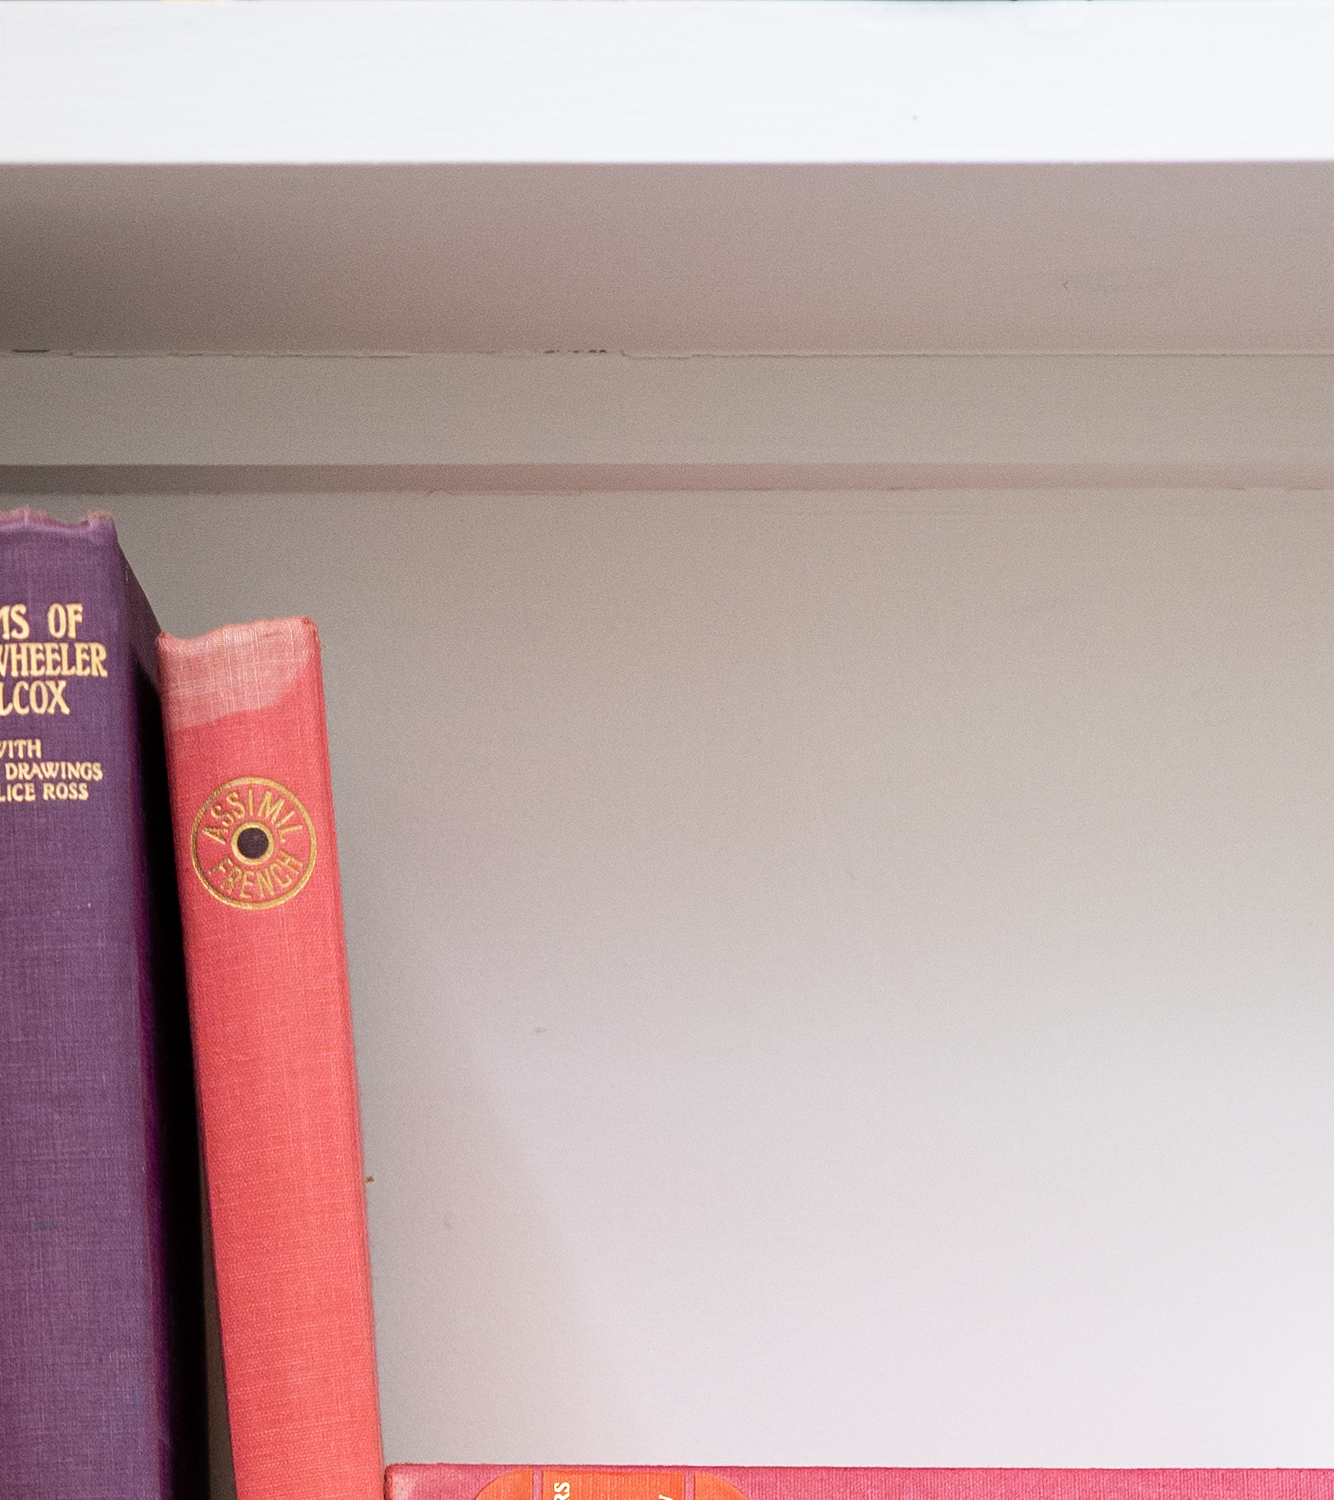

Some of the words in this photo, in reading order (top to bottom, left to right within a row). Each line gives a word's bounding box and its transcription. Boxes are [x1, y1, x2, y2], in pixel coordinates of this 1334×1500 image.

[48, 603, 83, 639] OF
[4, 760, 104, 782] DRAWINGS
[42, 781, 89, 801] ROSS
